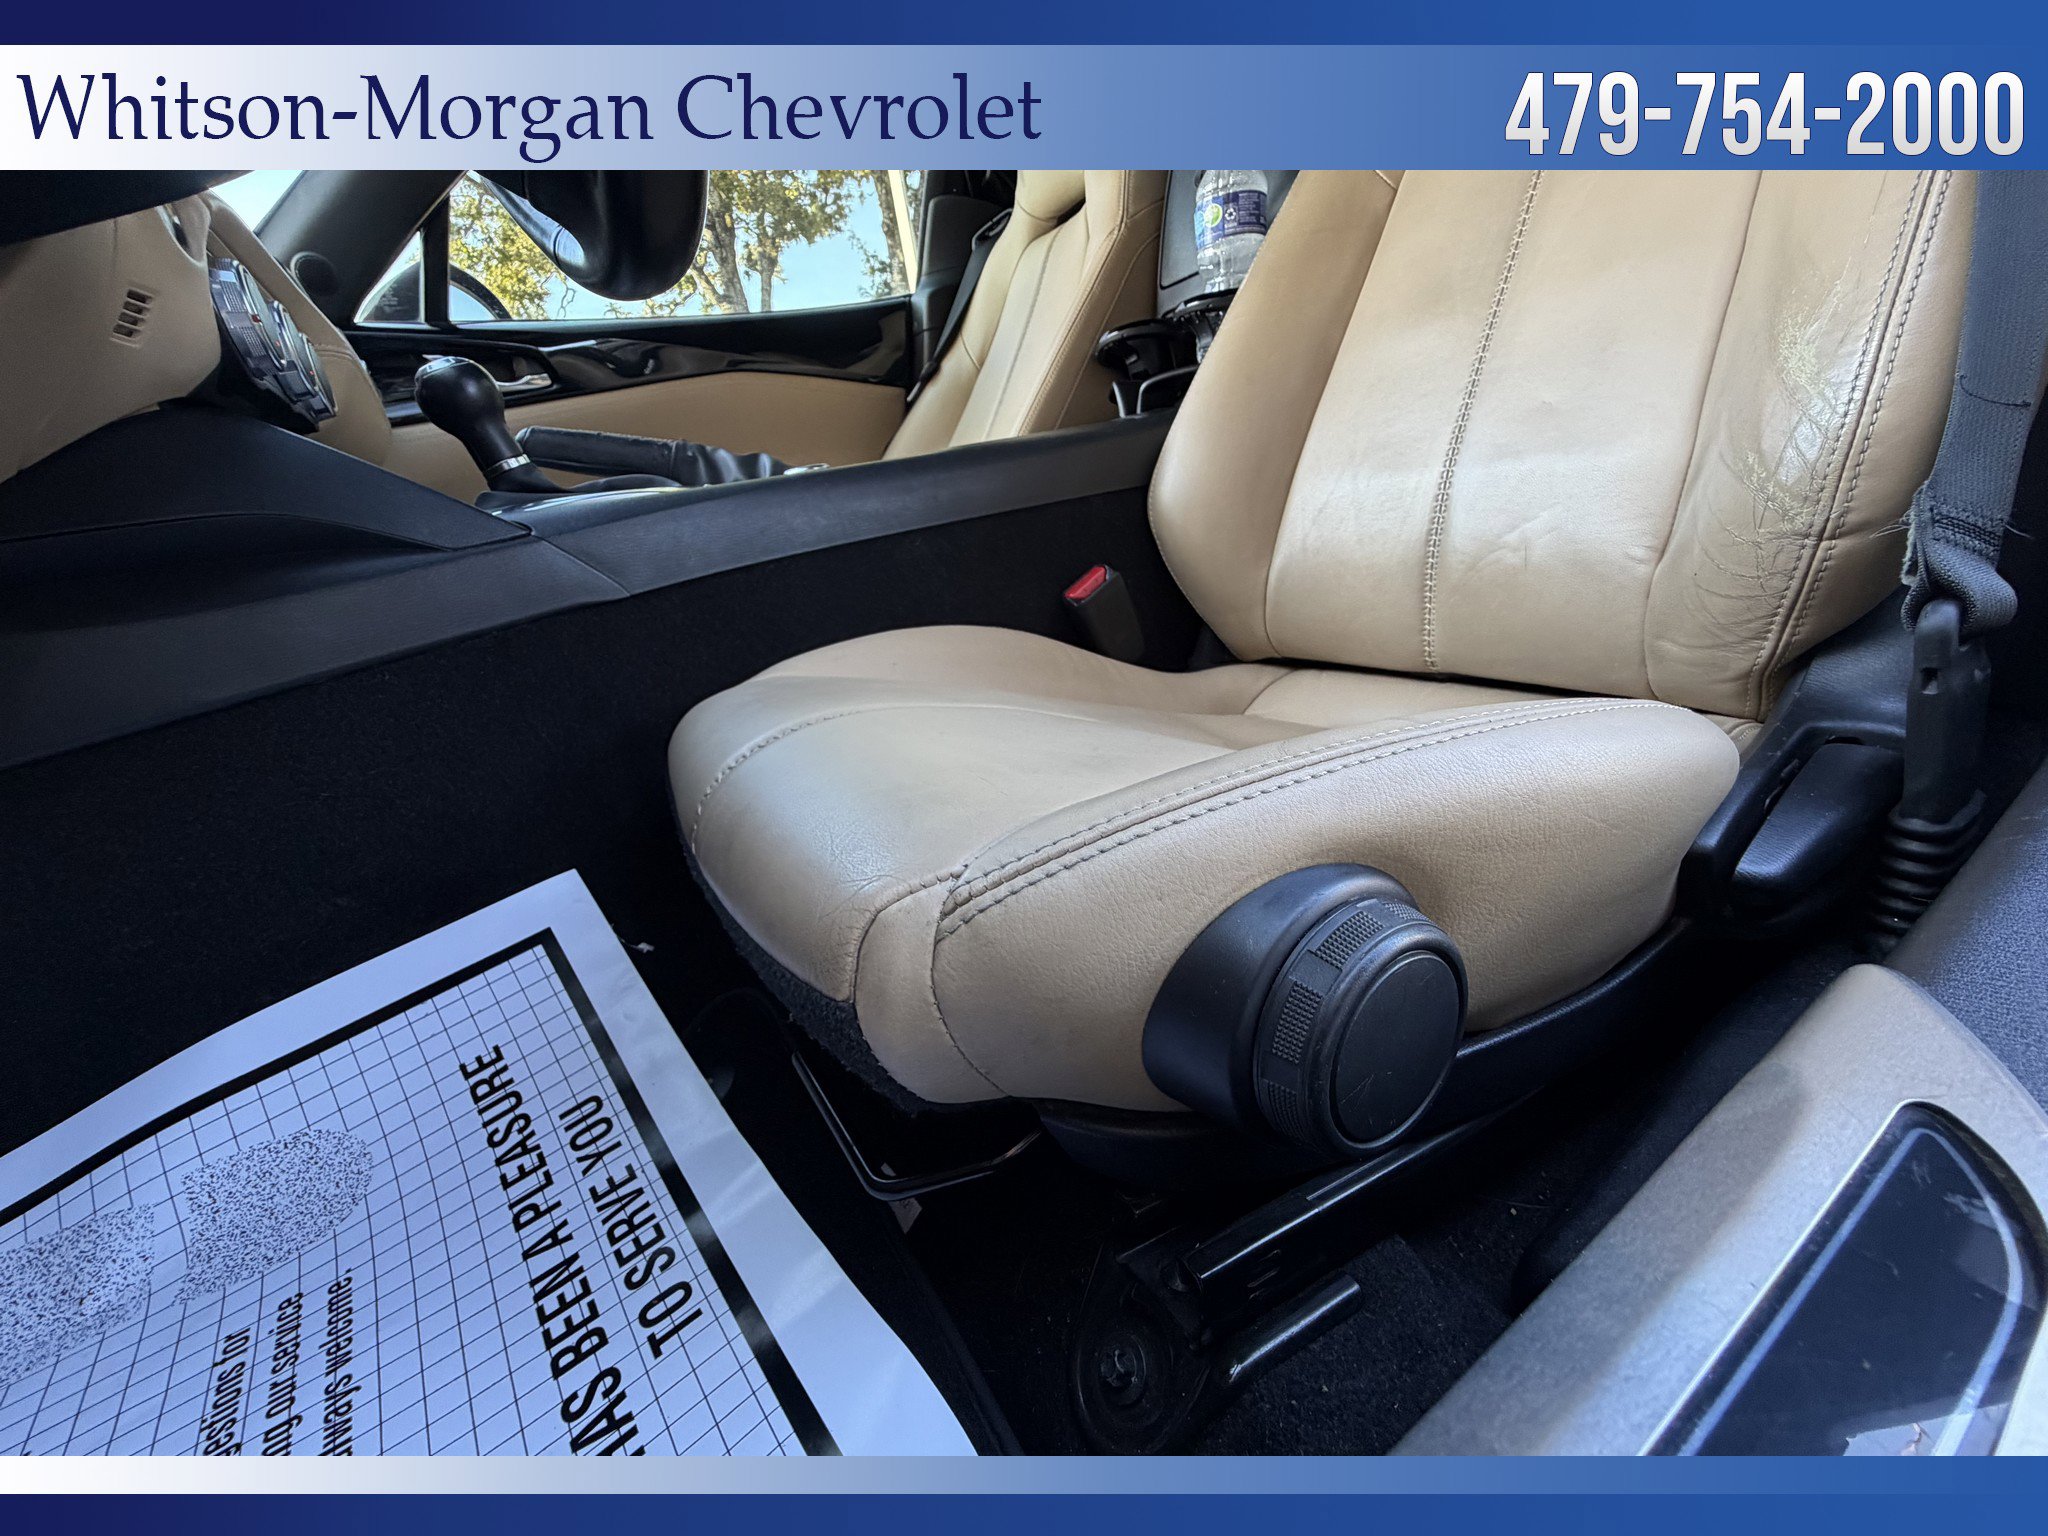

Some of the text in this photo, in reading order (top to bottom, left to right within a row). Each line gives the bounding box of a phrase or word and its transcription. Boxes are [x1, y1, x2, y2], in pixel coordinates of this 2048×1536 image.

[459, 1044, 562, 1233] PLEASURE
[521, 1218, 574, 1261] A
[558, 1095, 703, 1360] TO SERVE YOU
[212, 1328, 251, 1368] for
[268, 1292, 304, 1375] service
[319, 1268, 353, 1378] welcome.
[529, 1251, 609, 1381] BEEN
[265, 1374, 297, 1419] our
